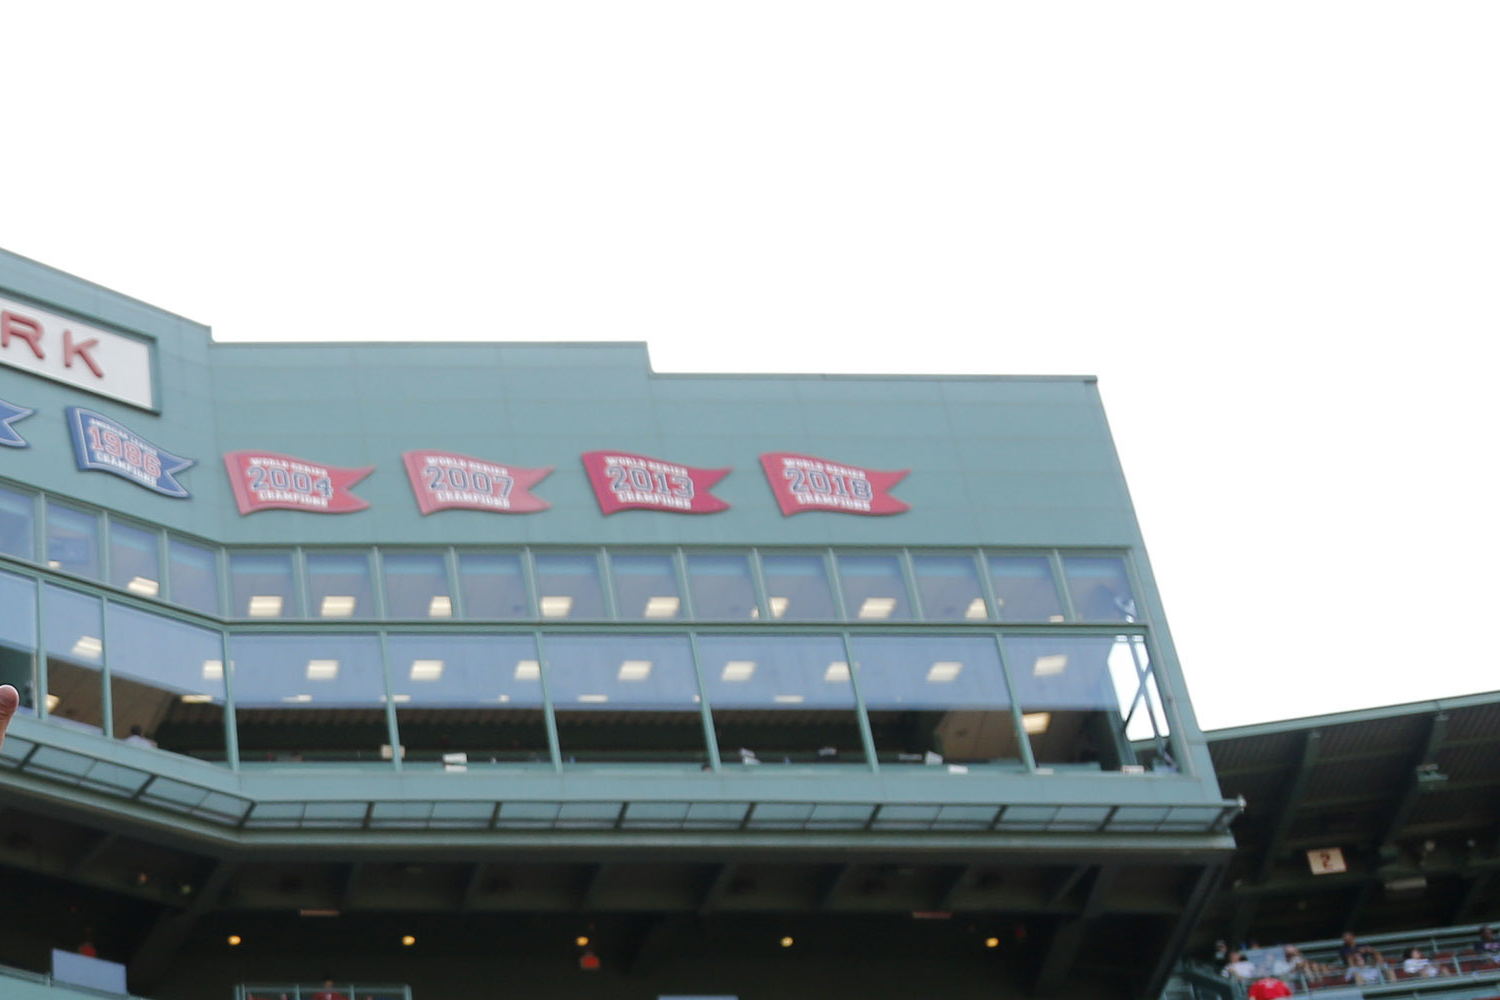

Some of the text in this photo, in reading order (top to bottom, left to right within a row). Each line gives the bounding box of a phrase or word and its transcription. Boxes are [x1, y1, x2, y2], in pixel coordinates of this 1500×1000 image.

[88, 425, 162, 478] 1986
[605, 455, 688, 477] WORLD SERIES
[247, 466, 333, 500] 2004
[424, 465, 514, 499] 2007
[605, 465, 695, 501] 2013
[784, 467, 873, 502] 2018
[258, 490, 329, 508] CHAMPIONS
[436, 490, 510, 510] CHAMPIONS
[618, 489, 692, 510] CHAMPIONS
[796, 492, 871, 512] CHAMPIONS
